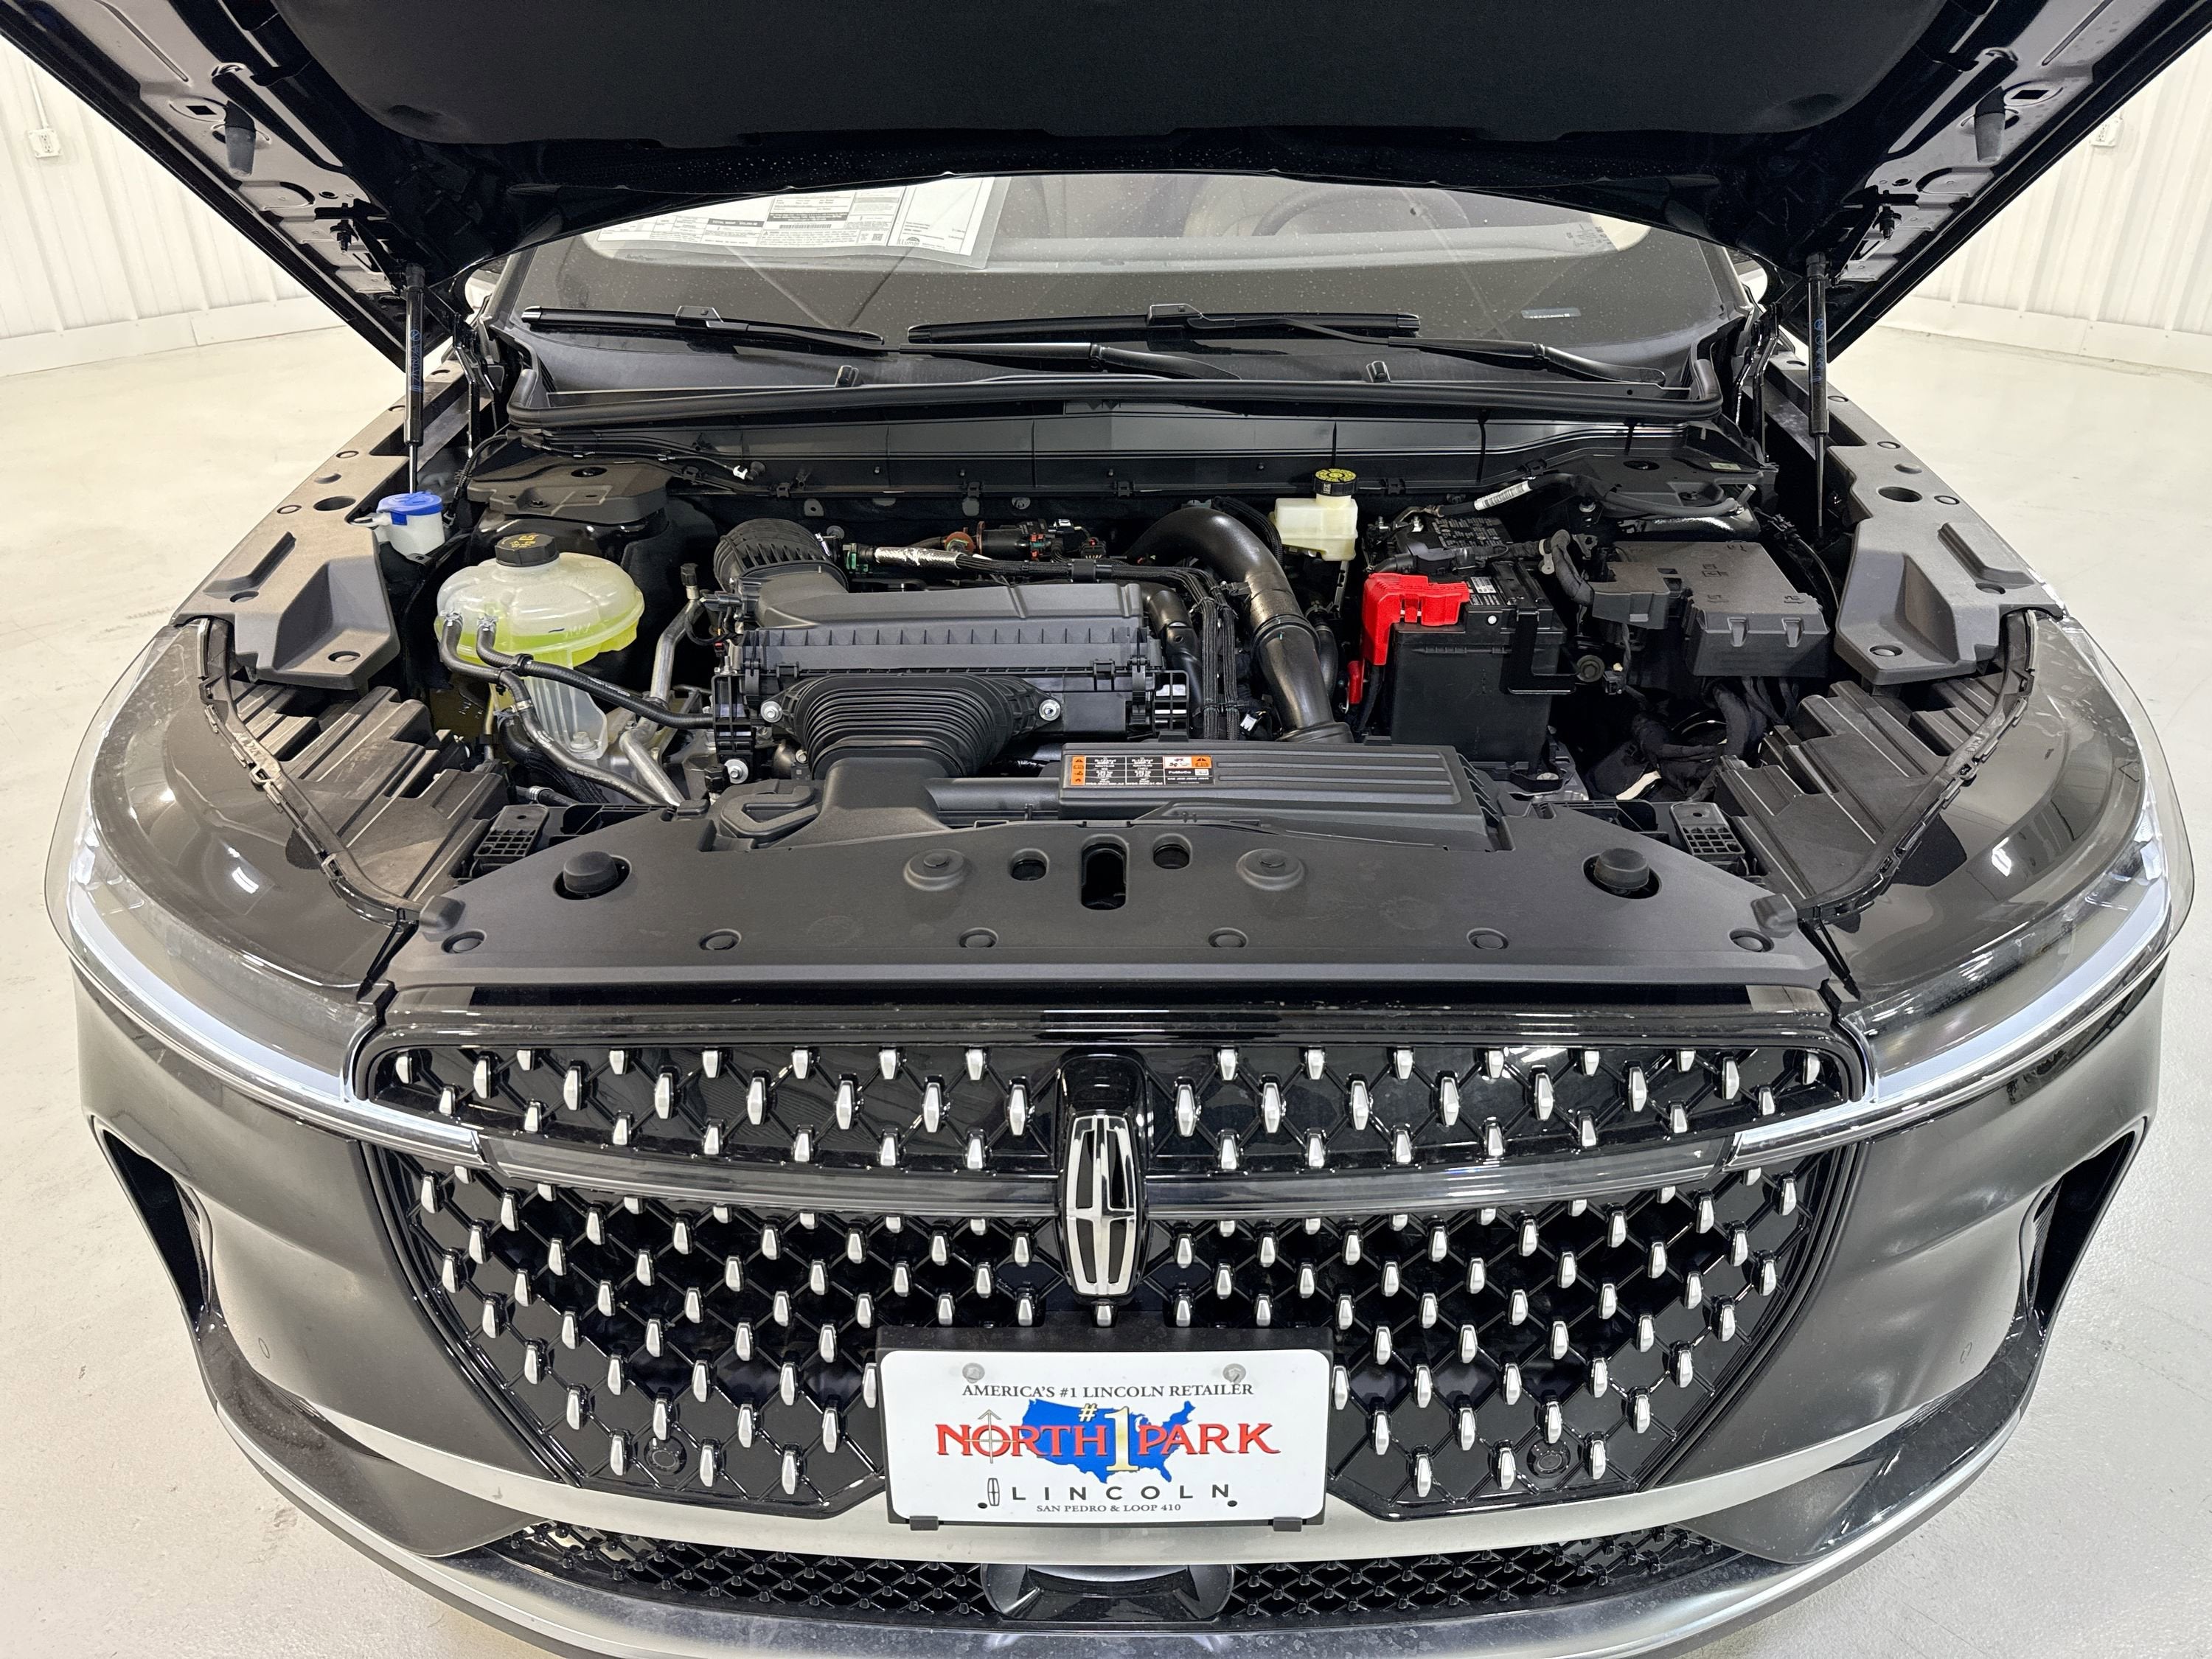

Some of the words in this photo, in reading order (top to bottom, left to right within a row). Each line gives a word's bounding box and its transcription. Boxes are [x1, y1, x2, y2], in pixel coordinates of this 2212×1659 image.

[961, 1385, 1055, 1398] AMERICA'S
[1060, 1387, 1077, 1398] #1
[1083, 1385, 1164, 1398] LINCOLN
[1169, 1383, 1254, 1397] RETAILER
[935, 1423, 1107, 1458] NORTH
[1138, 1422, 1281, 1456] PARK
[1012, 1484, 1229, 1501] LINCOLN
[1161, 1503, 1181, 1512] 410
